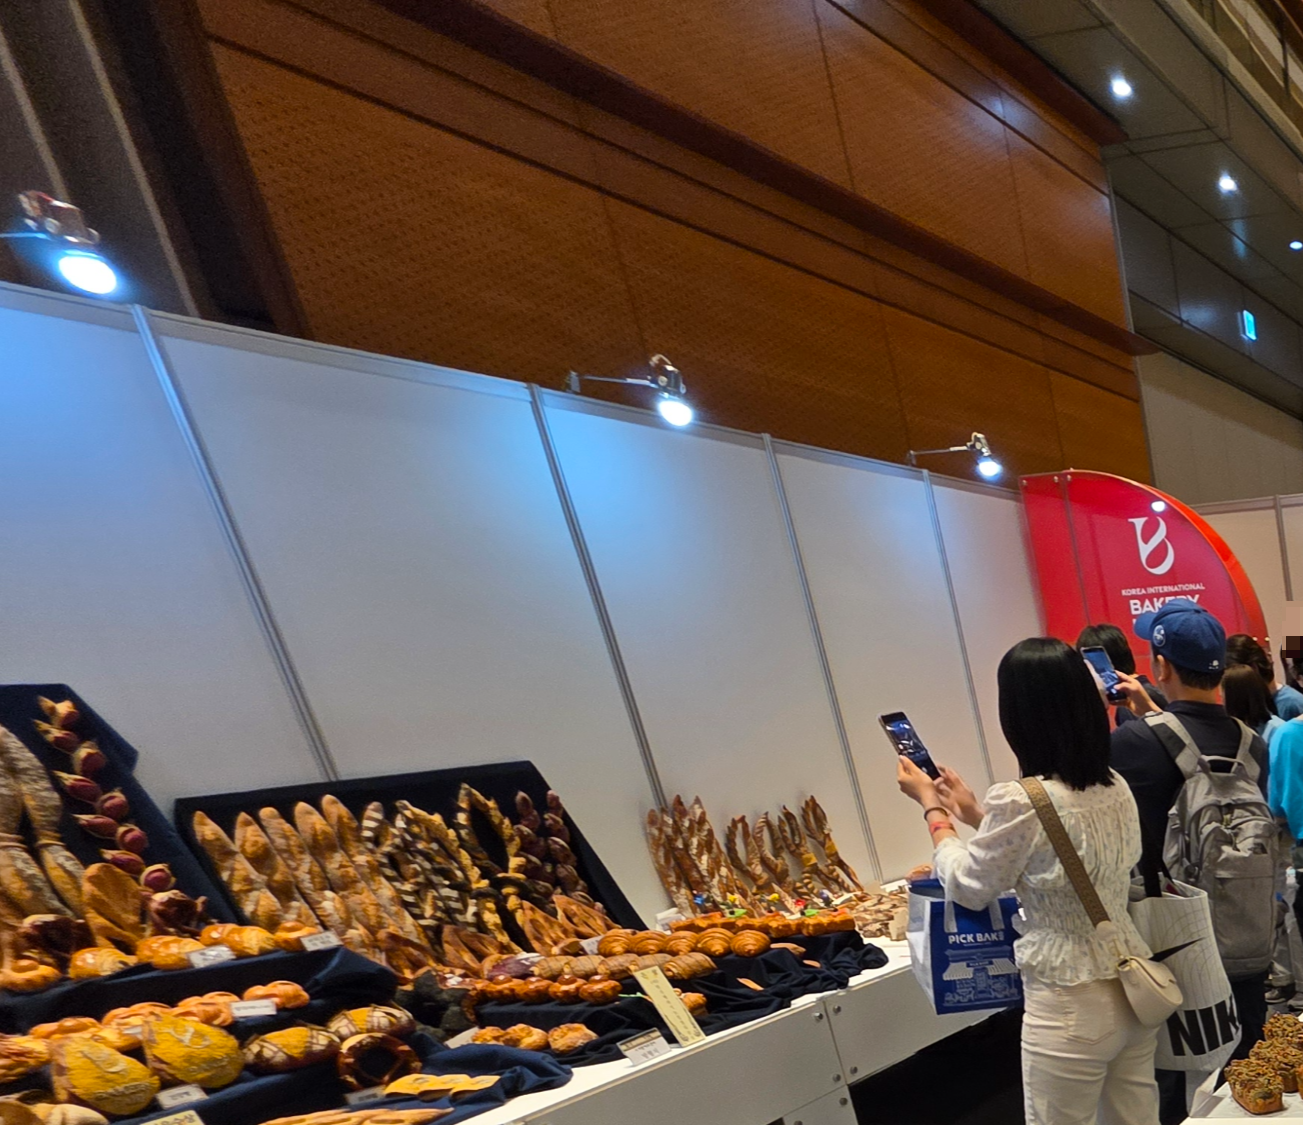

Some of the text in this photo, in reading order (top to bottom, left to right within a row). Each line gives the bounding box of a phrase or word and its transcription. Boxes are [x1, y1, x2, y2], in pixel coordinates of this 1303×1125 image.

[1121, 582, 1205, 596] KOREA INTERNATIONAL
[948, 934, 975, 945] PICK
